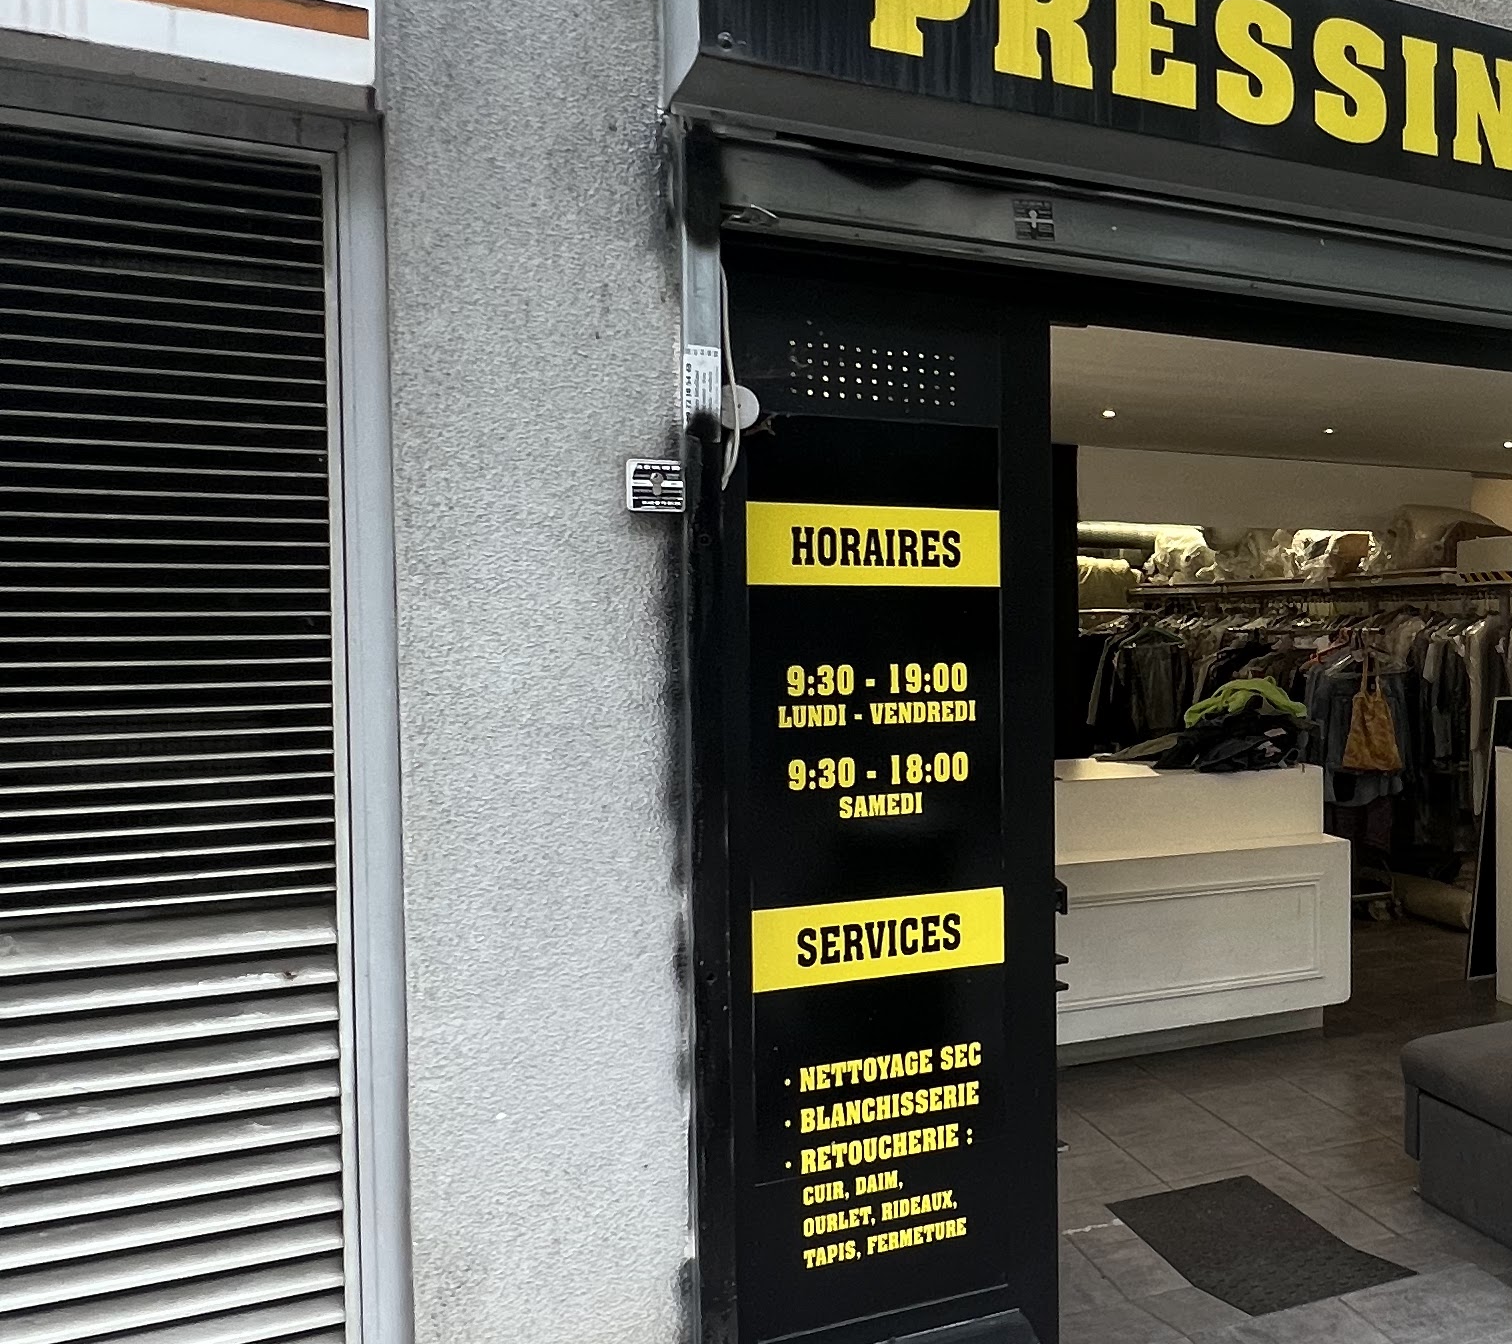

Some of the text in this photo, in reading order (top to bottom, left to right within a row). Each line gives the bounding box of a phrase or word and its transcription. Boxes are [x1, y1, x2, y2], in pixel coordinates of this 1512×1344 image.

[791, 525, 962, 569] HORAIRES
[786, 664, 855, 697] 9:30
[889, 662, 968, 694] 19:00
[777, 704, 847, 729] LUNDI
[869, 699, 977, 725] VENDREDI
[788, 756, 856, 791] 9:30
[890, 751, 969, 785] 18:00
[838, 791, 923, 819] SAMEDI
[796, 912, 962, 968] SERVICES
[799, 1041, 982, 1093] NETTOYAGE SEC
[800, 1080, 980, 1134] BLANCHISSERIE
[800, 1122, 960, 1175] RETOUCHERIE
[802, 1169, 904, 1206] CUIR, DAIM,
[803, 1189, 958, 1238] OURLET, RIDEAUX,
[803, 1216, 967, 1269] TAPIS, FERMETURE
